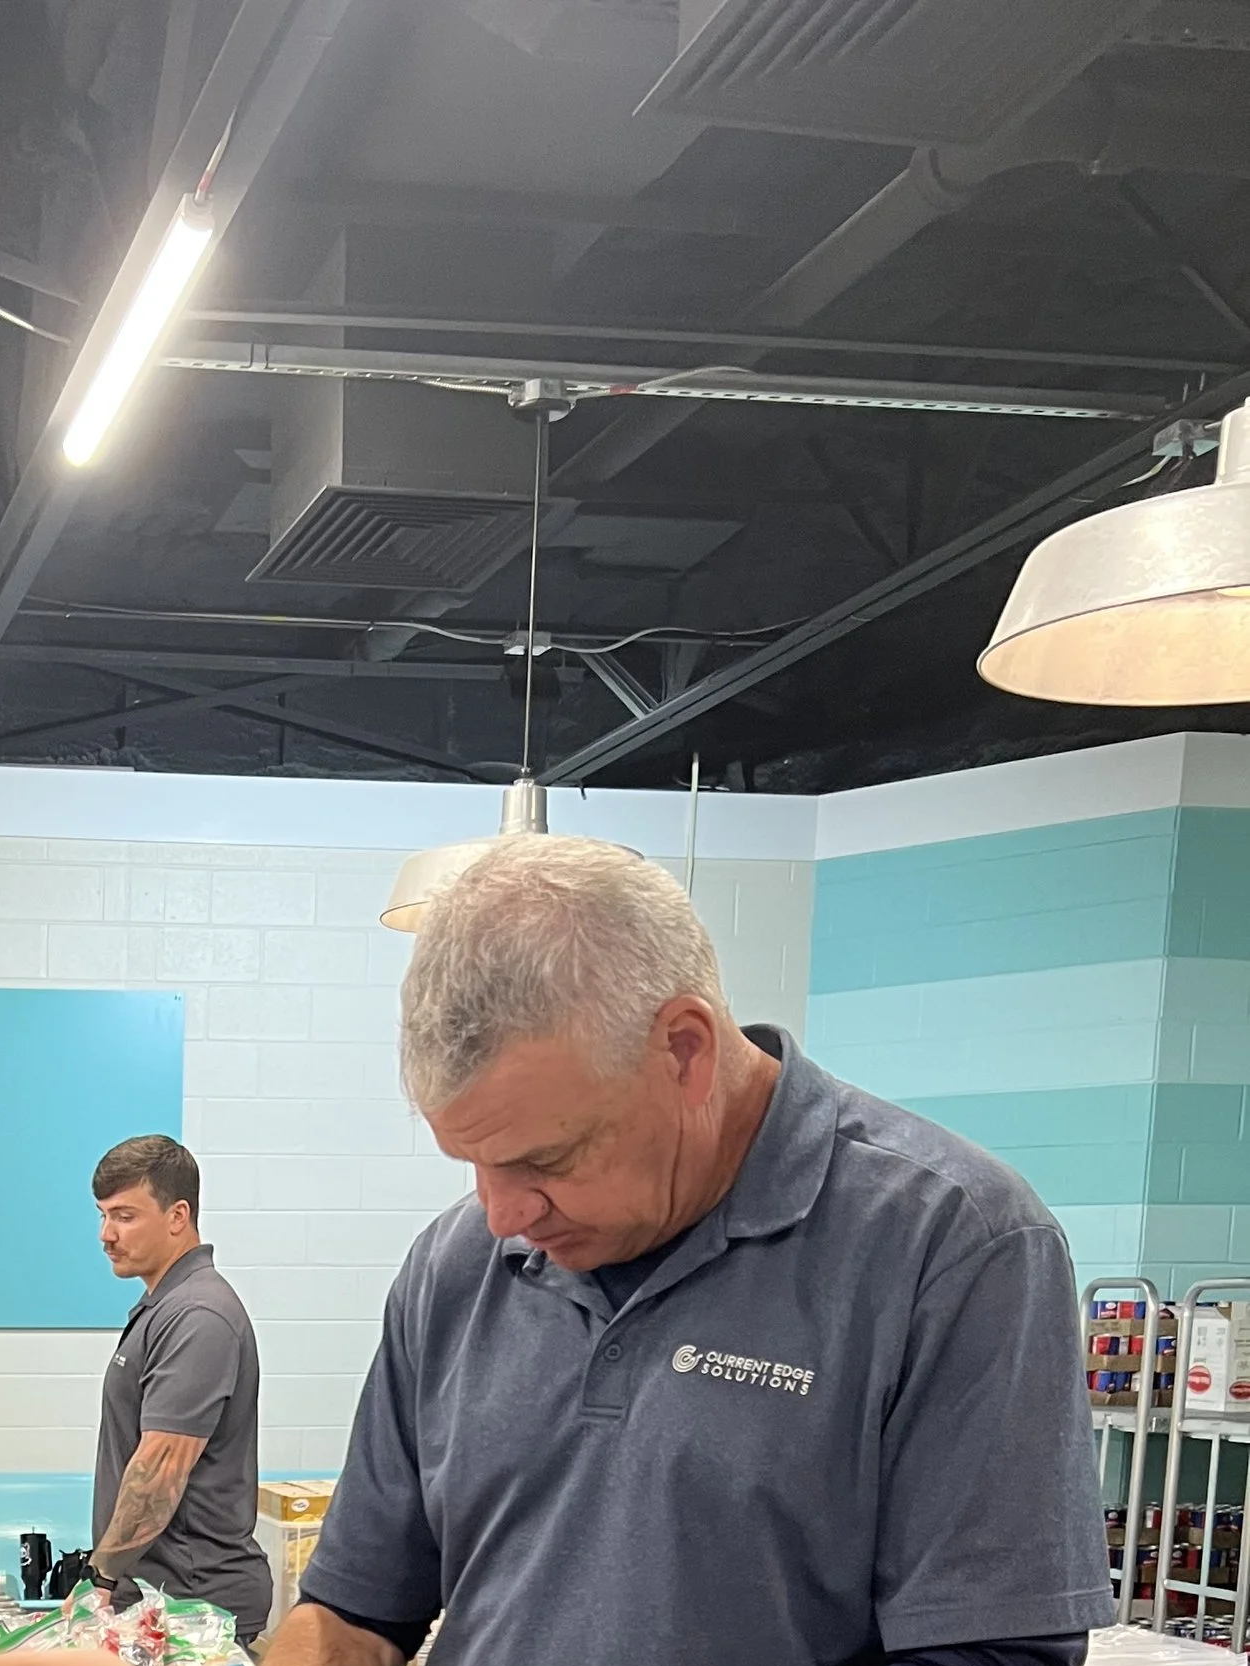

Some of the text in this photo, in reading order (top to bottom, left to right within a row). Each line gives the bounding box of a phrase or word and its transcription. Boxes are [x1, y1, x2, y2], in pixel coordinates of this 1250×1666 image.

[700, 1363, 810, 1395] SOLUTIONS
[706, 1351, 815, 1384] CURRENT EDGE
